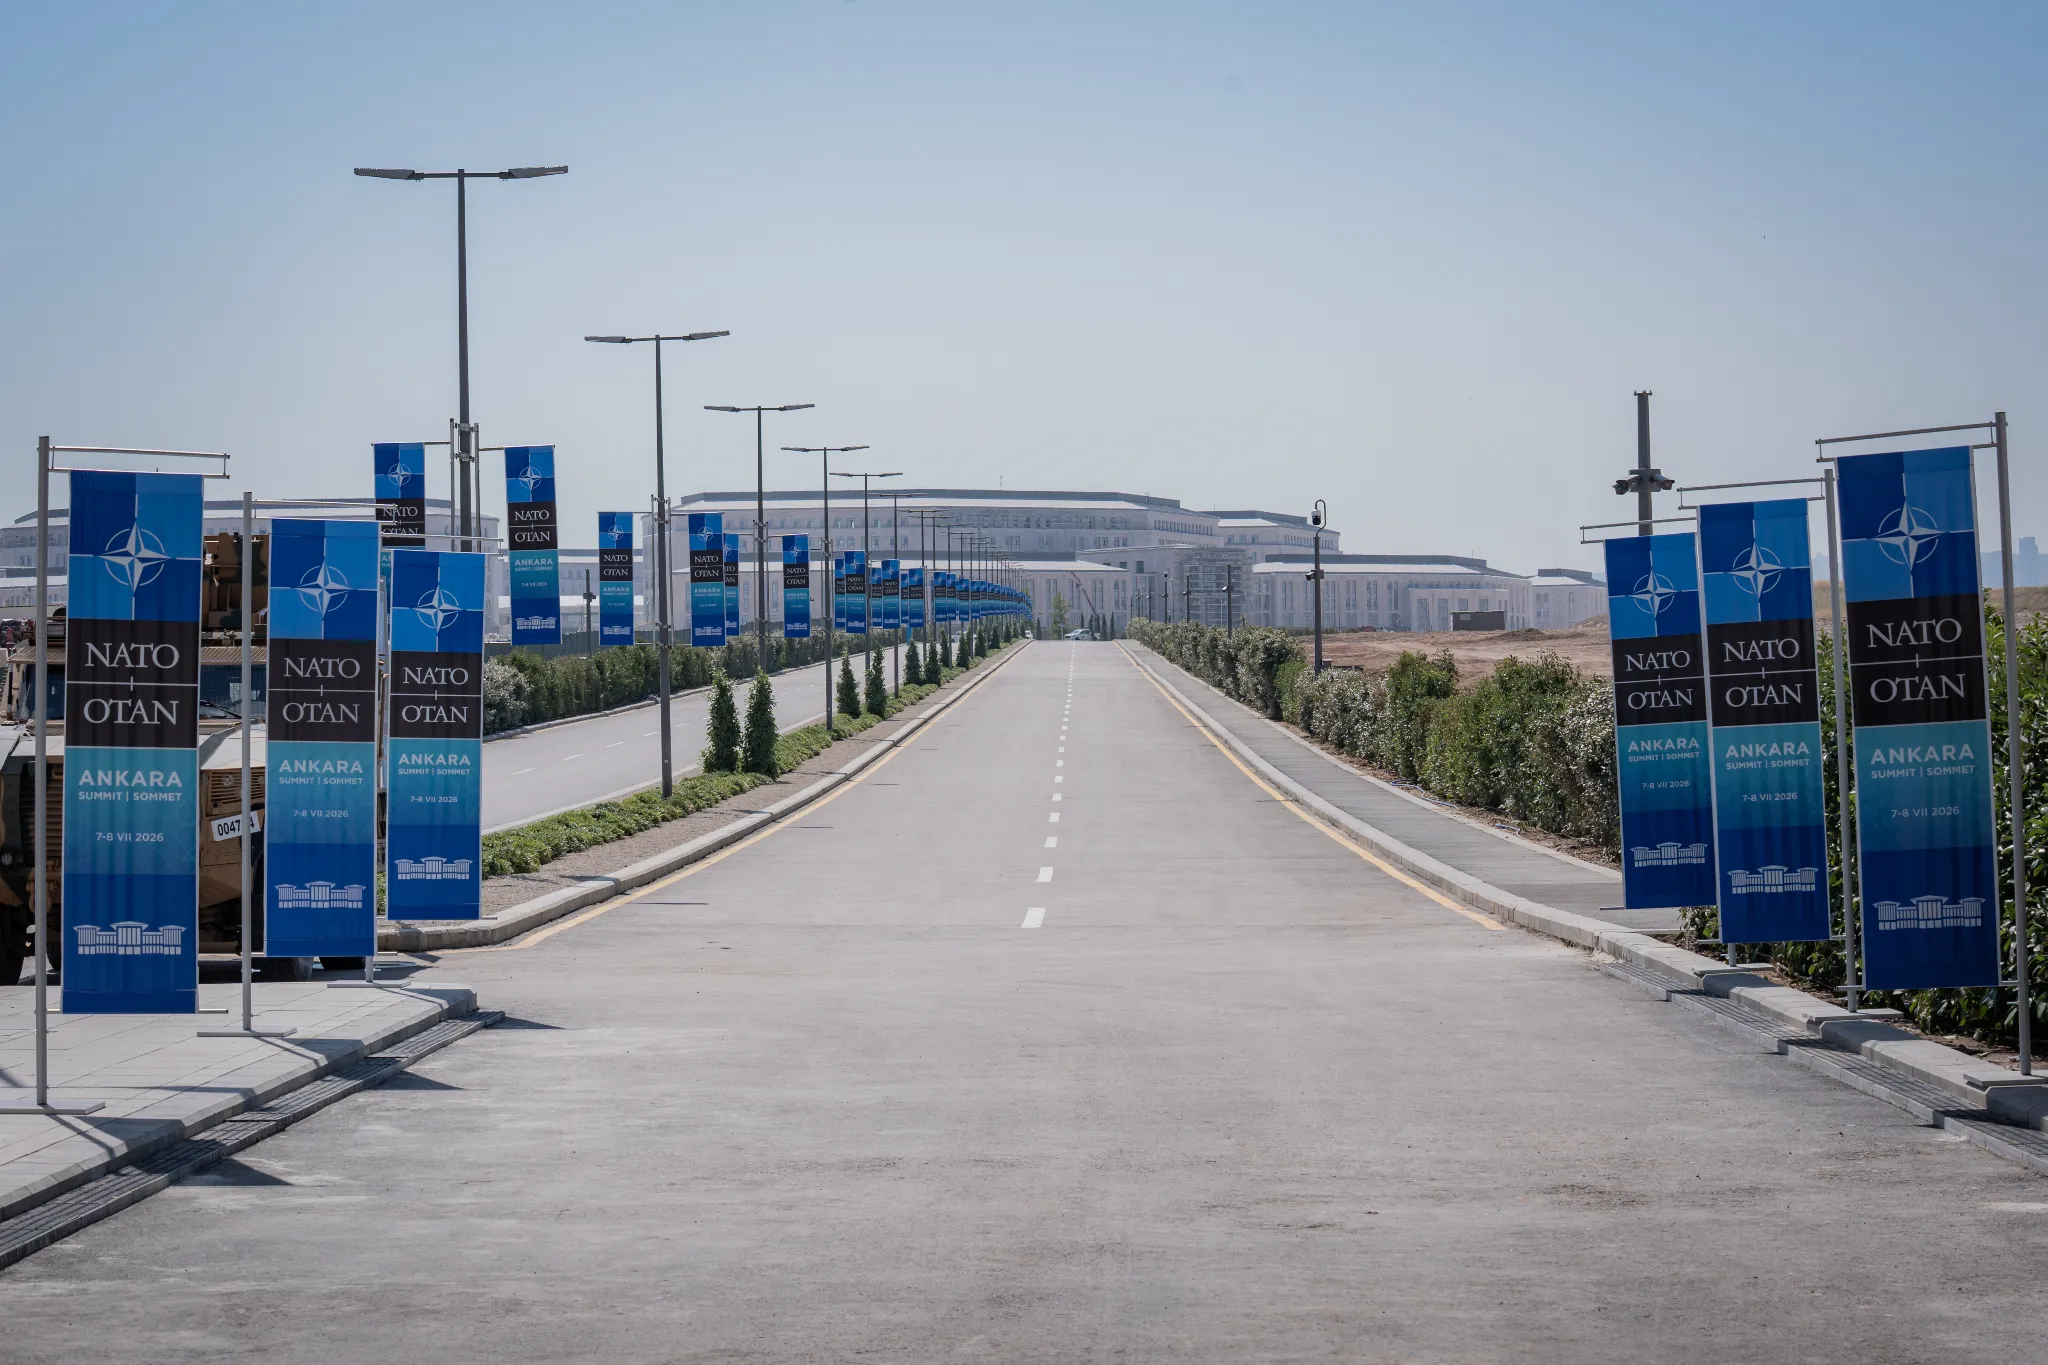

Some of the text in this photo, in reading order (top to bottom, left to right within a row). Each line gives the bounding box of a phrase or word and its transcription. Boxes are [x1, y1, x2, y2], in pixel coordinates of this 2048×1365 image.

[382, 506, 418, 517] NATO
[514, 509, 550, 521] NATO
[514, 531, 550, 543] OTAN
[514, 558, 553, 566] ANKARA
[603, 554, 629, 562] NATO
[694, 555, 719, 563] NATO
[603, 568, 629, 576] OTAN
[694, 569, 719, 578] OTAN
[1866, 618, 1962, 648] NATO
[85, 642, 179, 669] NATO
[1723, 638, 1800, 663] NATO
[283, 657, 360, 679] NATO
[1625, 650, 1690, 672] NATO
[402, 667, 469, 685] NATO
[1725, 683, 1803, 707] OTAN
[1869, 673, 1966, 703] OTAN
[1627, 688, 1693, 709] OTAN
[83, 698, 179, 725] OTAN
[282, 702, 360, 723] OTAN
[401, 704, 469, 724] OTAN
[1627, 736, 1700, 753] ANKARA
[1725, 741, 1810, 759] ANKARA
[398, 753, 471, 766] ANKARA
[1628, 751, 1700, 763] SUMMIT SOMMET
[1870, 743, 1975, 765] ANKARA
[279, 759, 364, 774] ANKARA
[1726, 758, 1810, 770] SUMMIT SOMMET
[78, 769, 183, 788] ANKARA
[1871, 765, 1975, 779] SUMMIT SOMMET
[278, 776, 364, 785] SUMMIT SOMMET
[1669, 780, 1690, 788] 2026
[78, 791, 183, 801] SUMMIT SOMMET
[1742, 792, 1798, 802] 7-8 VII 2026
[293, 809, 349, 818] 7-8 VII 2026
[1891, 806, 1960, 818] 7-8 VII 2026
[217, 816, 255, 836] 00474
[96, 832, 164, 842] 7-8 VII 2026
